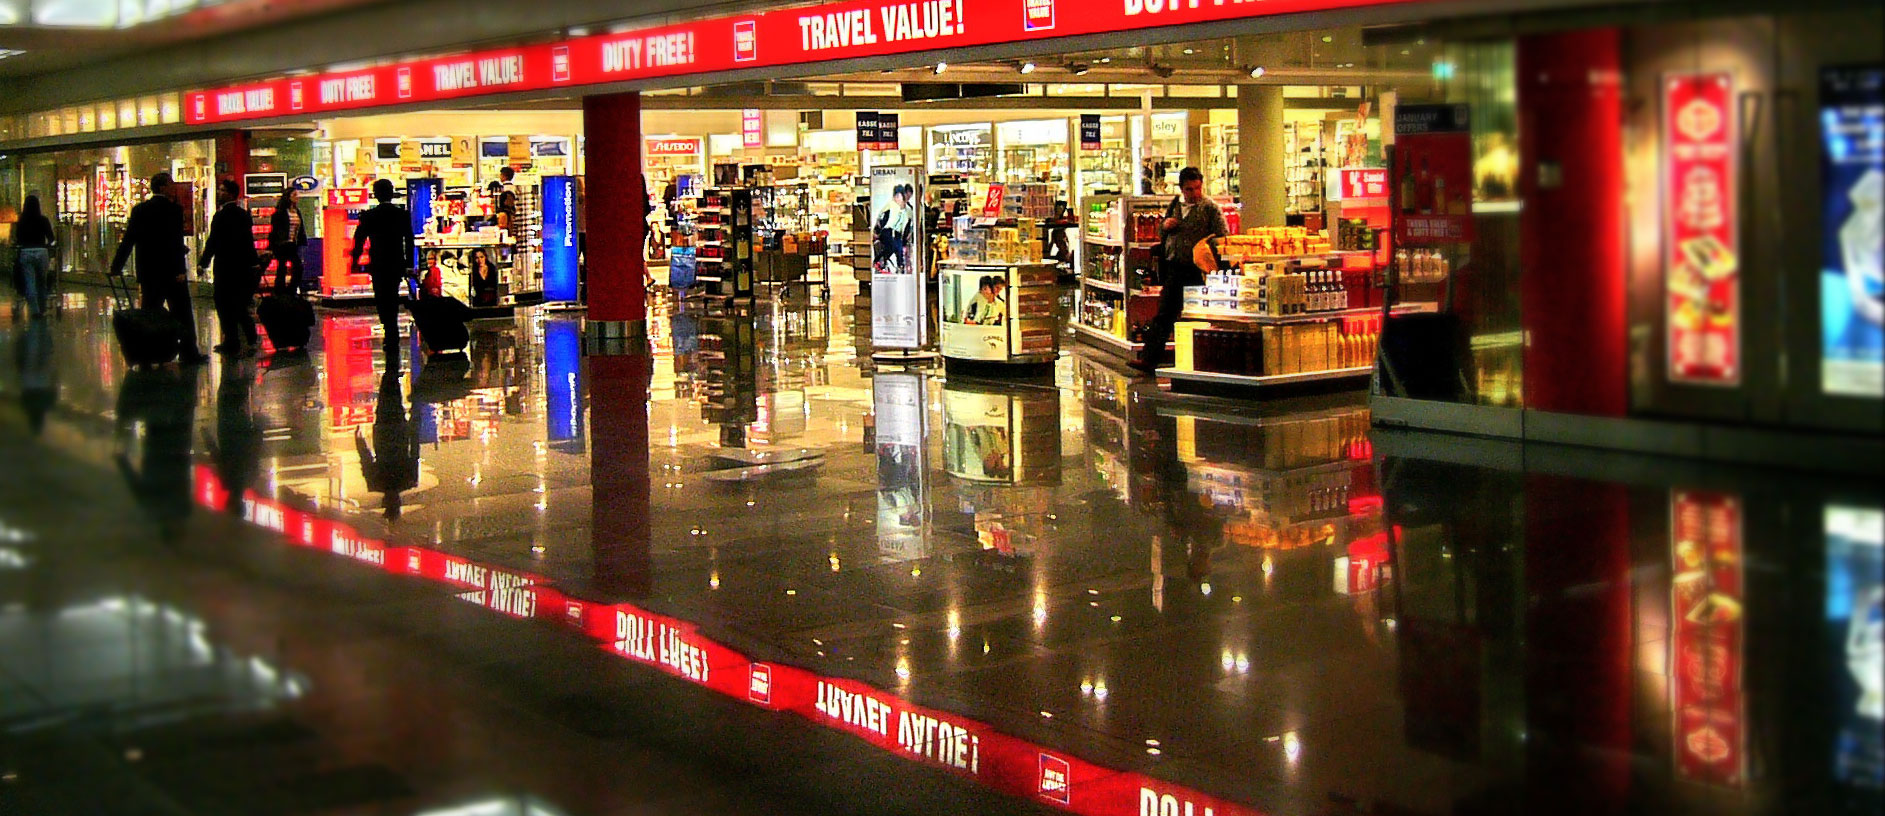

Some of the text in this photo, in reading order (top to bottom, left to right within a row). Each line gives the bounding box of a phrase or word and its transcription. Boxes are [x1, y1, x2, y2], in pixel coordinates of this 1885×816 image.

[799, 0, 965, 50] TRAVEL VALUE!
[602, 38, 643, 72] DUTY
[646, 31, 695, 67] FREE!
[320, 78, 345, 104] DUTY
[346, 74, 376, 102] FREE!
[433, 61, 478, 91] TRAVEL
[478, 55, 524, 86] VALUE!
[563, 181, 573, 247] Promotion
